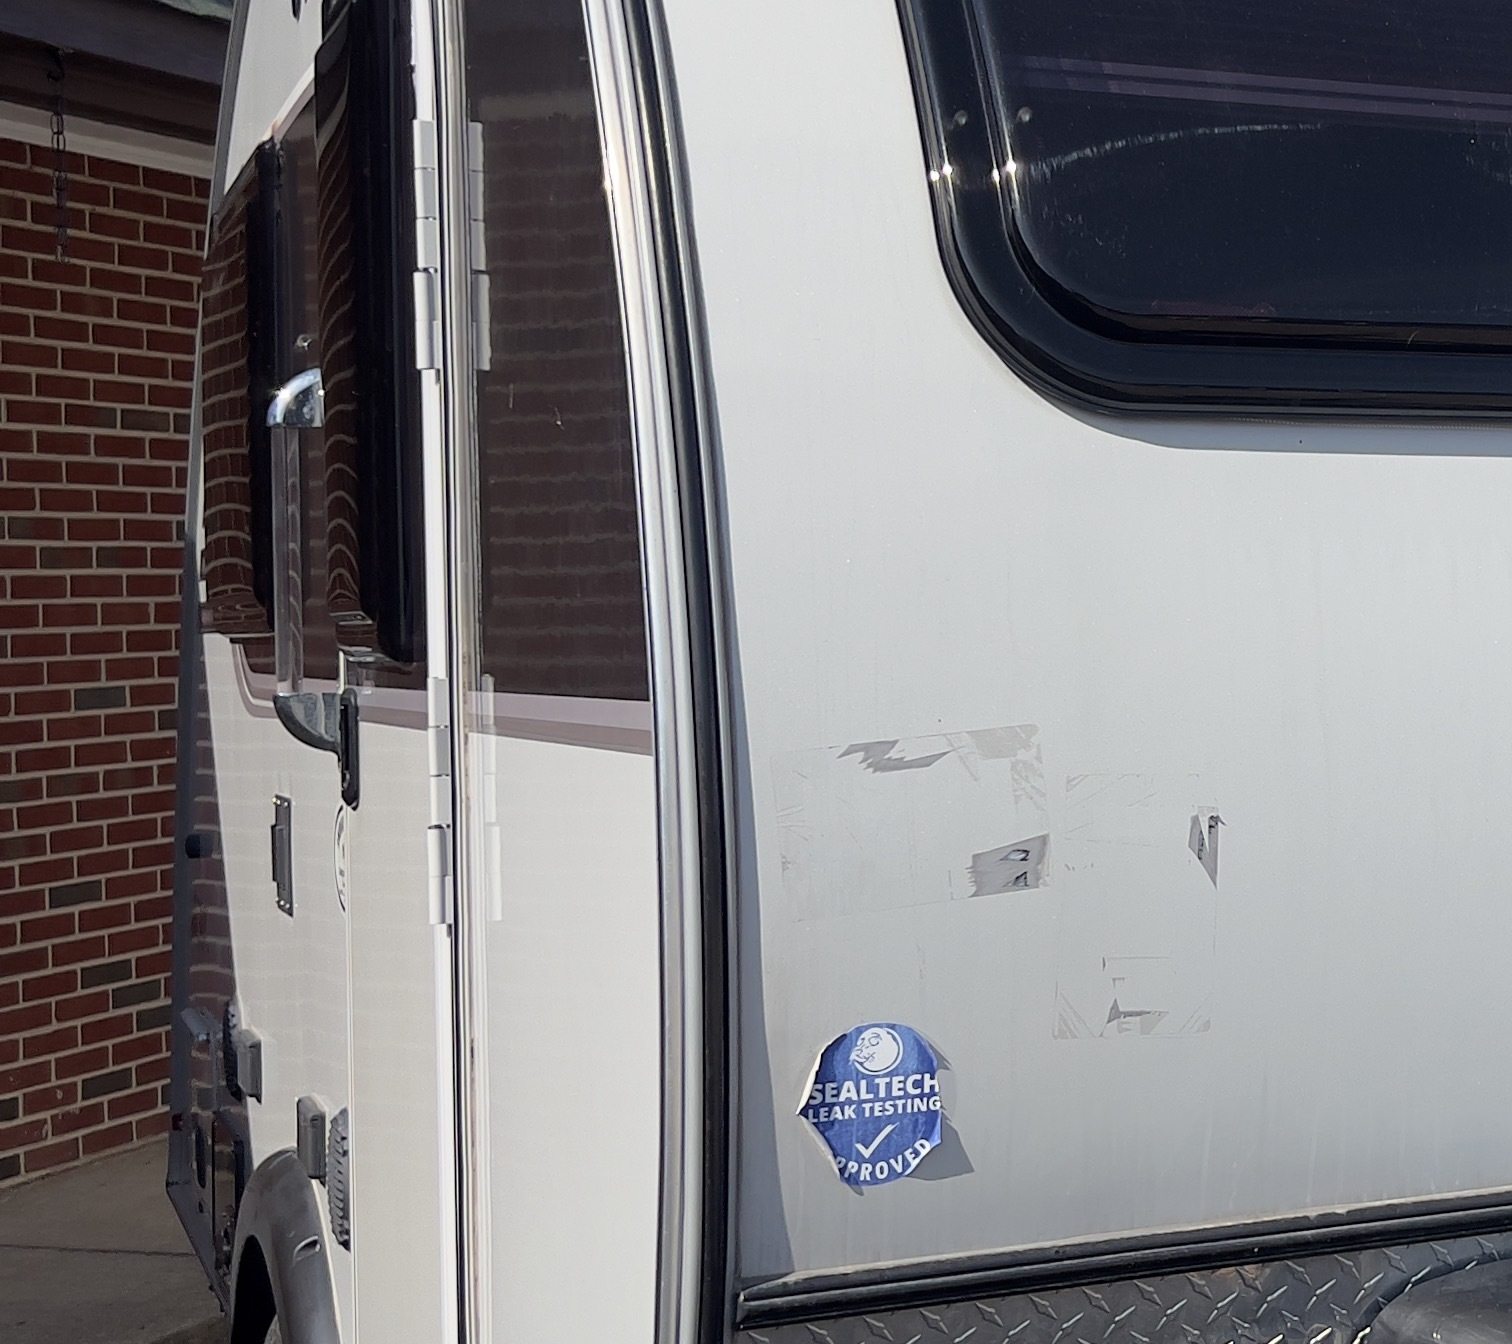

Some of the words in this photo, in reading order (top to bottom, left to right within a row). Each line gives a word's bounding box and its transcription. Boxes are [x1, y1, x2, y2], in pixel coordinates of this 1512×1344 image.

[809, 1073, 940, 1105] SEALTECH
[807, 1105, 857, 1123] LEAK
[862, 1096, 942, 1118] TESTING
